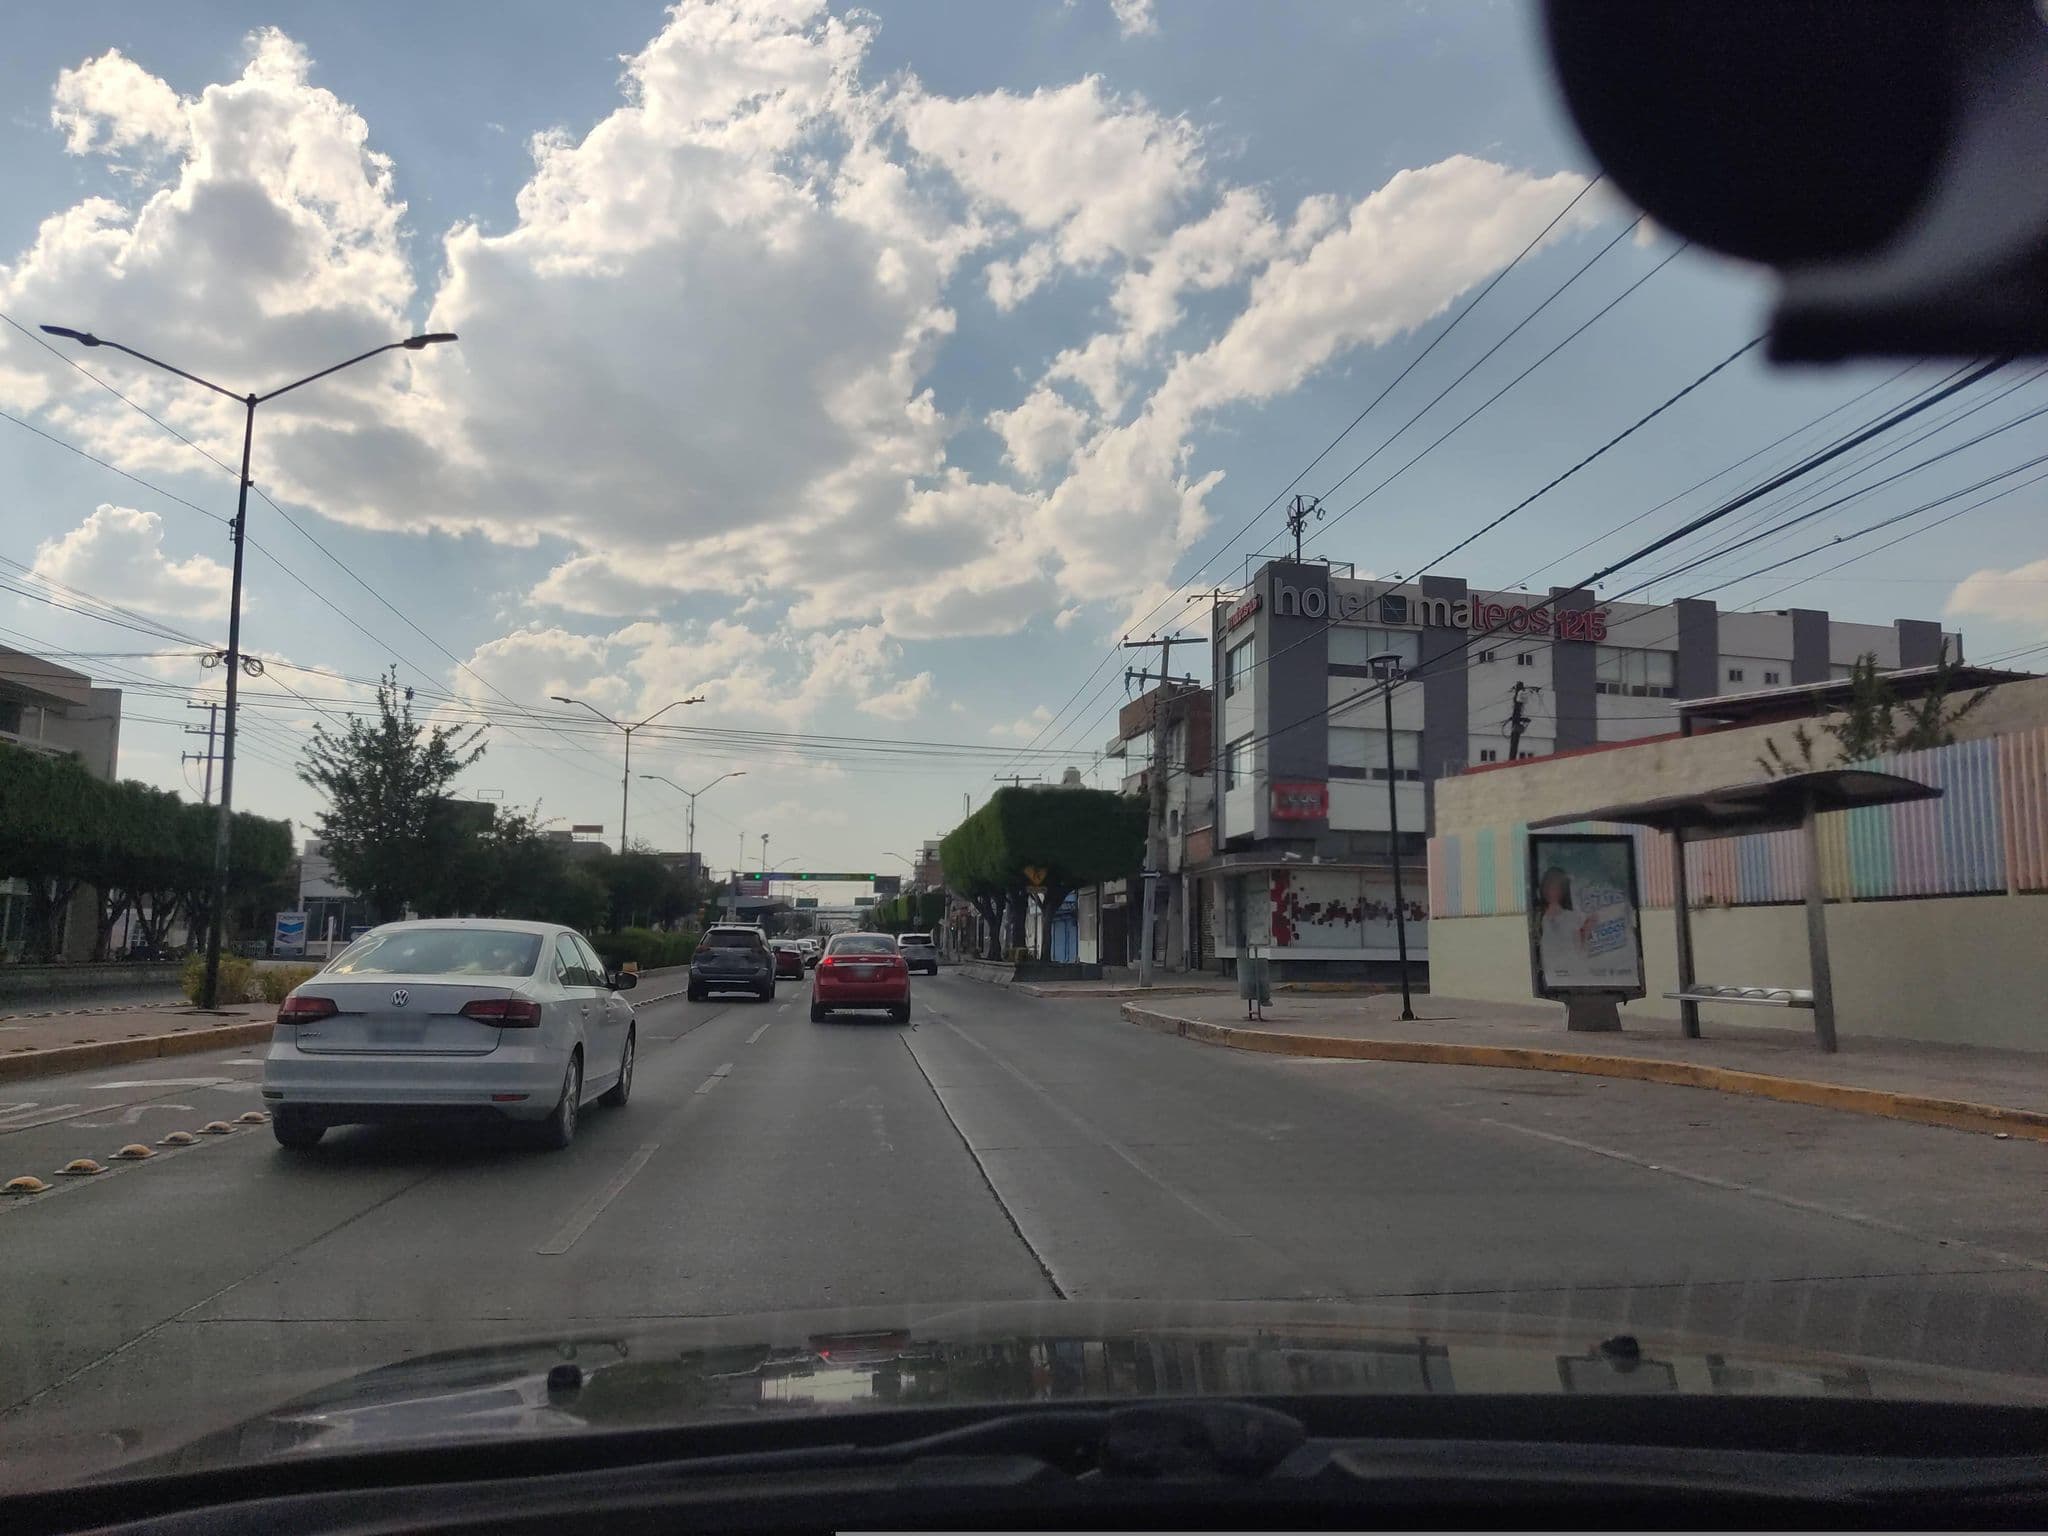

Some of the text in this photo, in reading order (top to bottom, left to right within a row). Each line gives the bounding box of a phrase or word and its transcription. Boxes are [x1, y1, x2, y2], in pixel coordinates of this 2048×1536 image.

[1273, 576, 1373, 621] hotel
[1415, 594, 1550, 634] mateos
[1555, 609, 1608, 643] 1215
